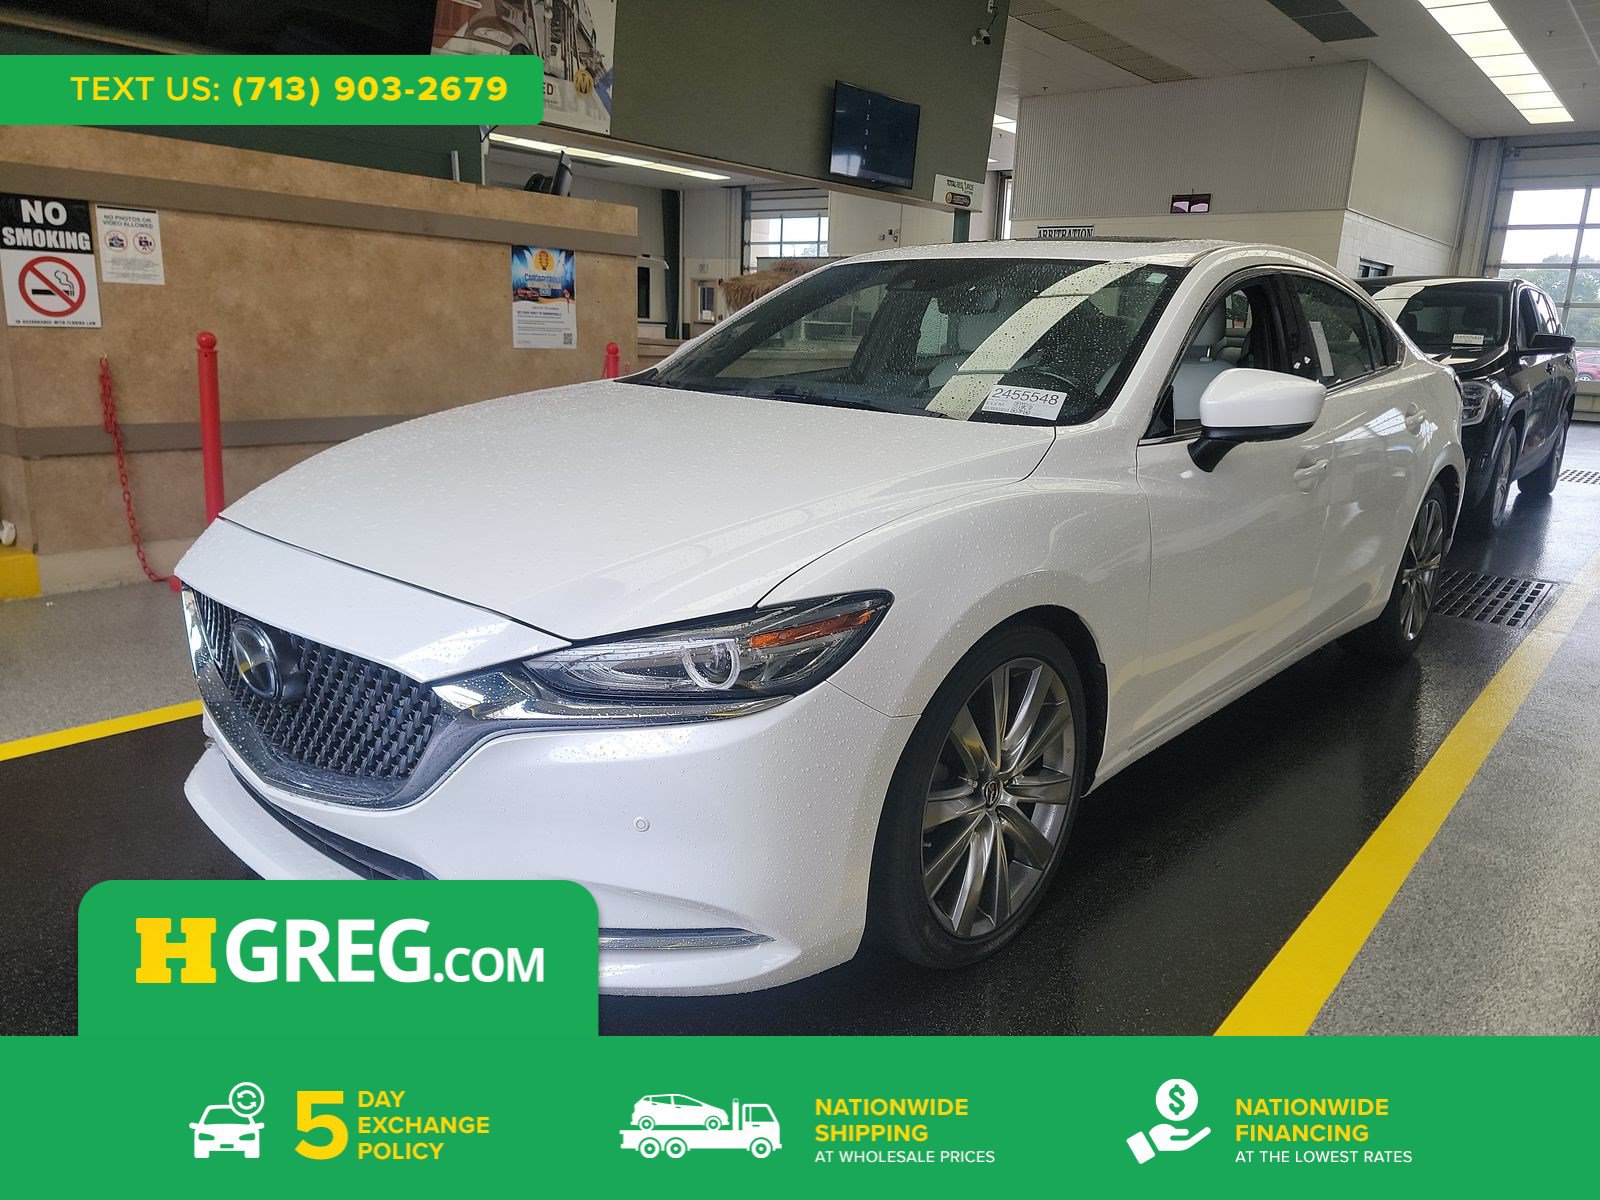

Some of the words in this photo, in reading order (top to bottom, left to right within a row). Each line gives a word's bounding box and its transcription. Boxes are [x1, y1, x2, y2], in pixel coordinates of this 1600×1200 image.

[20, 199, 67, 226] NO
[2, 226, 92, 251] SMOKING
[1037, 228, 1094, 239] ARBITRATION
[992, 388, 1059, 405] 2455548
